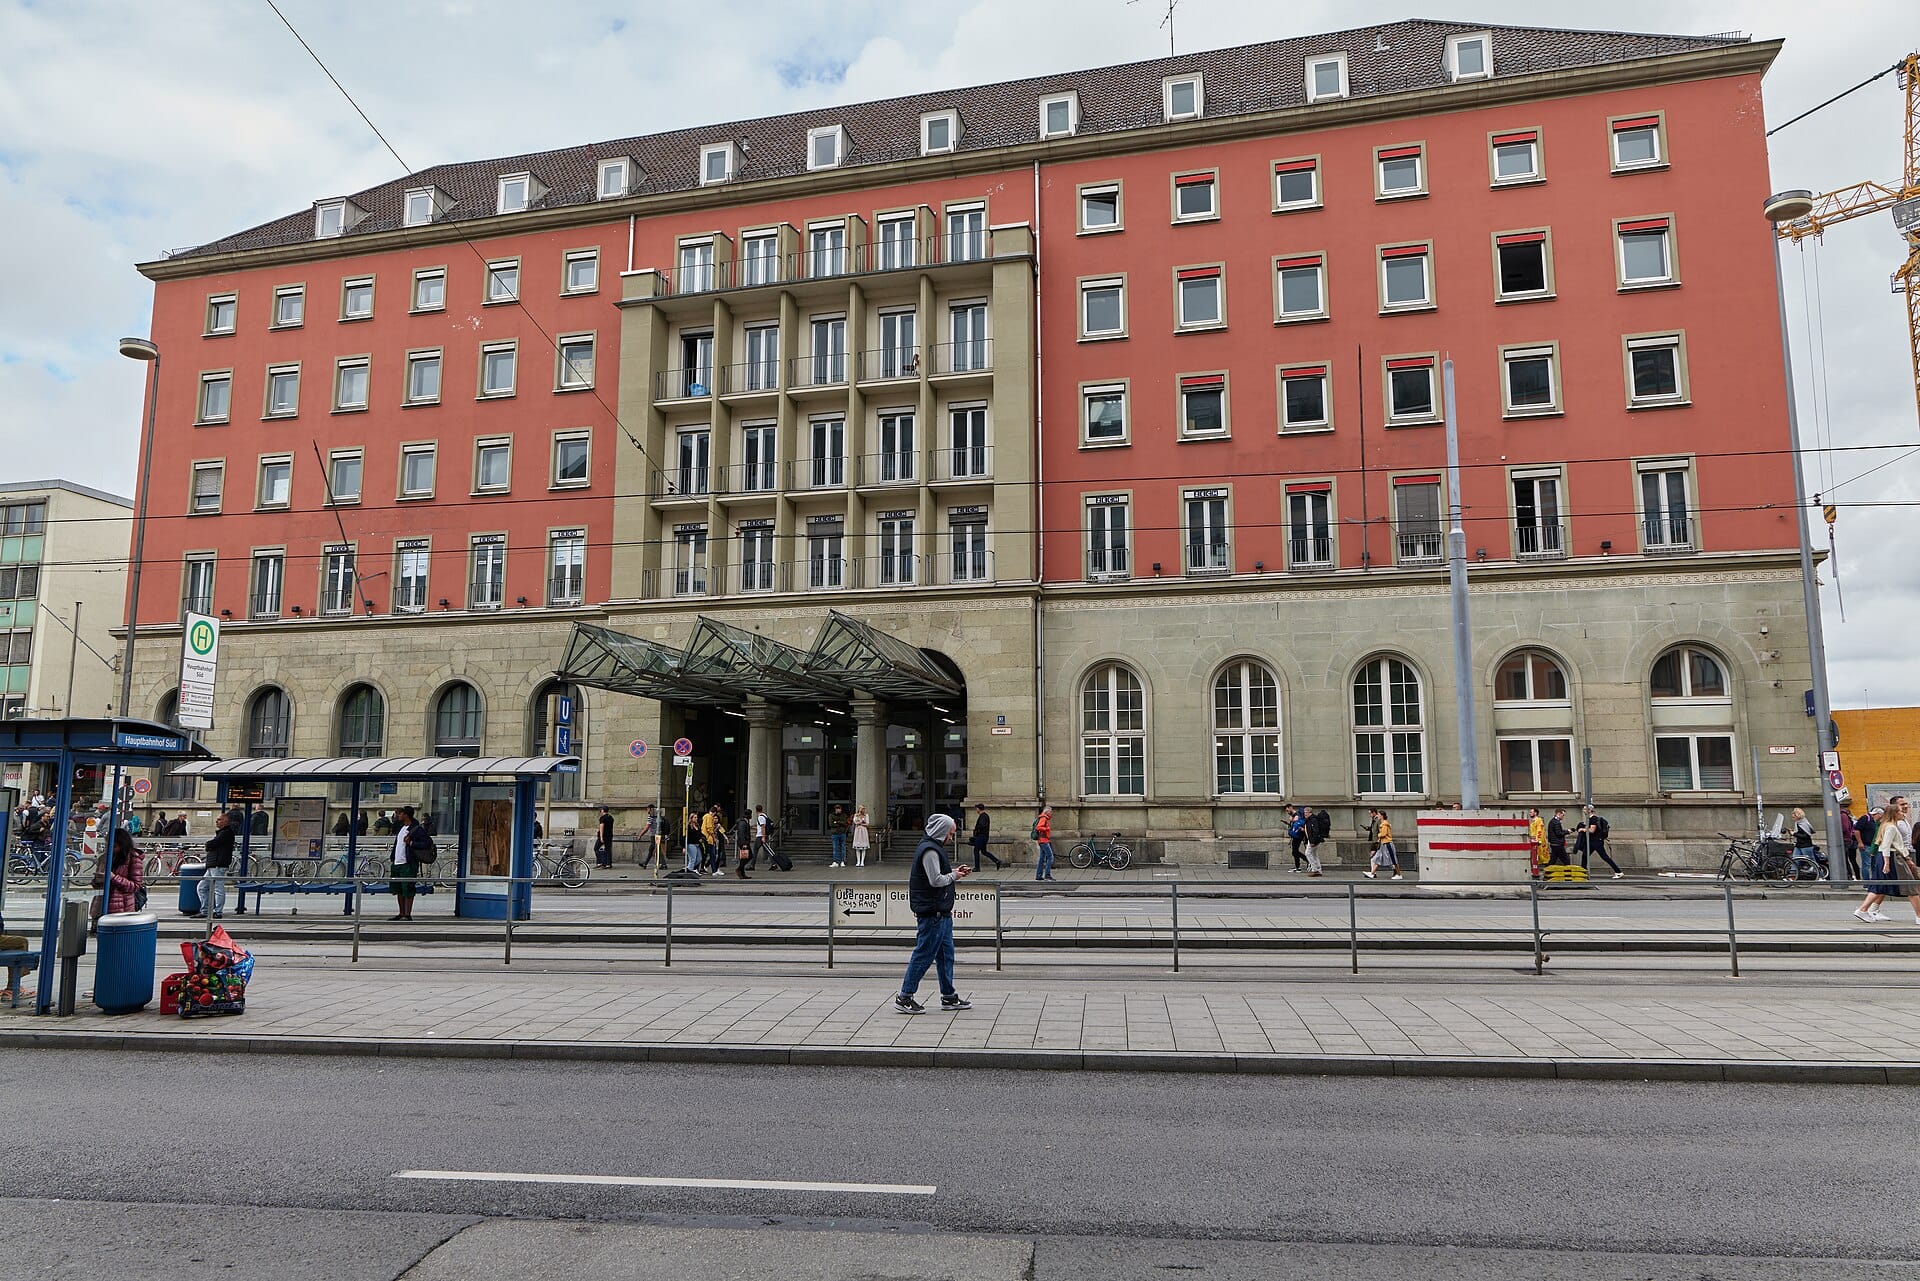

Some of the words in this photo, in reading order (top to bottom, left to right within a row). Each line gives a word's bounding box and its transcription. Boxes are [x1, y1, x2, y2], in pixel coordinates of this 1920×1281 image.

[196, 627, 209, 648] H
[562, 700, 570, 720] U
[125, 735, 165, 747] Hauptbahnhof
[165, 738, 177, 748] Süd
[836, 889, 881, 902] Übergang
[890, 891, 909, 901] Glei
[954, 891, 996, 901] betreten
